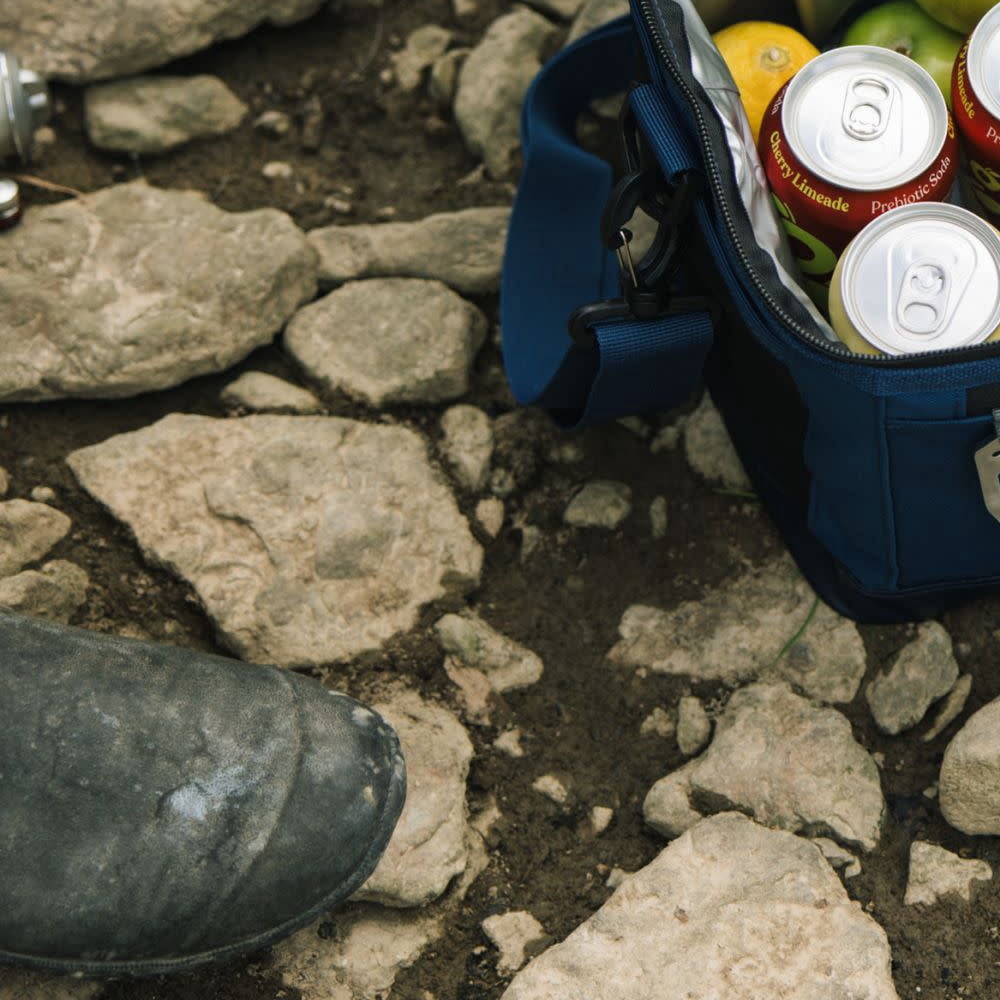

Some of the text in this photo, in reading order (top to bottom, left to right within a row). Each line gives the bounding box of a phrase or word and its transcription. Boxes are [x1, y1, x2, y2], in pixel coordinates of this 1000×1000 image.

[958, 61, 975, 118] Limeade
[770, 131, 850, 213] Cherry Limeade
[871, 155, 951, 214] Prebiotic Soda
